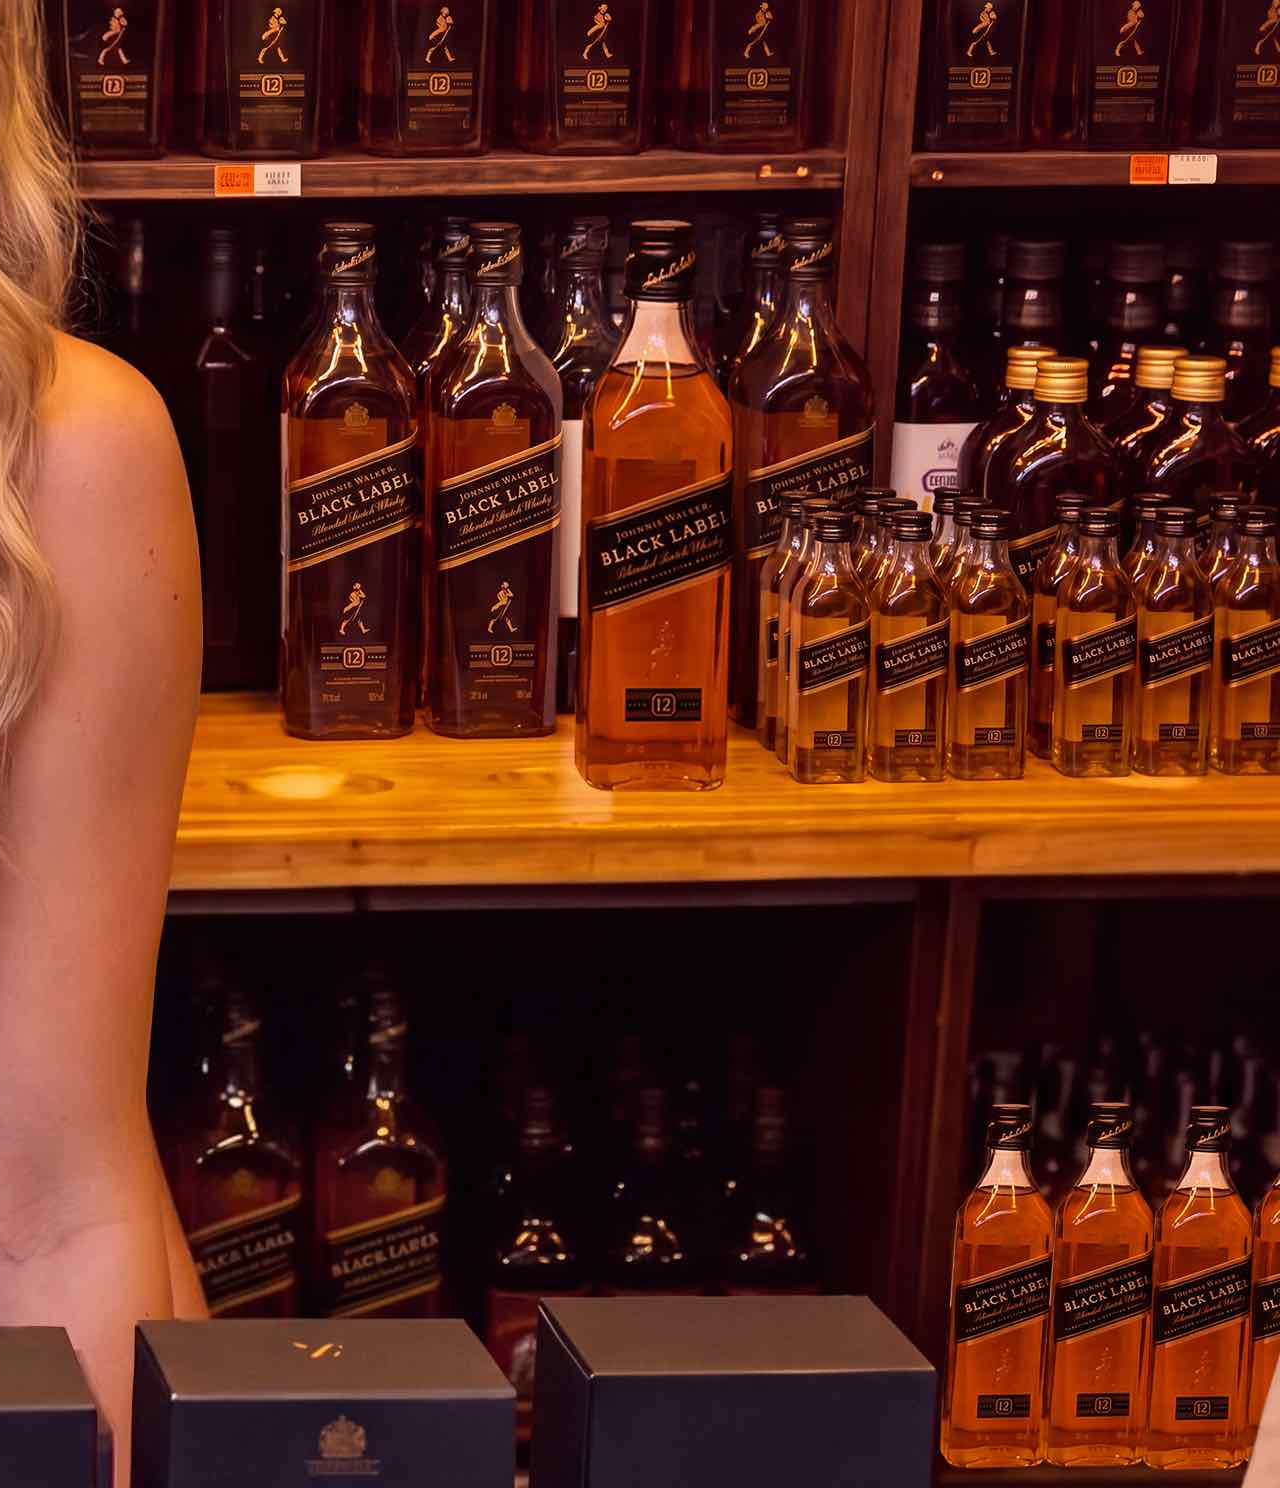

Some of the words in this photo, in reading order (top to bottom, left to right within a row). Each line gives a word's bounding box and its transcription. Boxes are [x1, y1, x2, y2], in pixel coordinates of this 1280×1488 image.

[298, 494, 356, 525] BLACK
[359, 473, 413, 502] LABEL
[445, 494, 503, 524] BLACK
[506, 472, 559, 502] LABEL
[601, 534, 664, 566] BLACK
[669, 511, 729, 542] LABEL
[804, 651, 836, 669] BLACK
[837, 640, 869, 658] LABEL
[884, 651, 916, 669] BLACK
[918, 639, 949, 657] LABEL
[1072, 645, 1104, 663] BLACK
[1106, 635, 1136, 652] LABEL
[965, 1292, 1008, 1313] BLACK
[1064, 1290, 1108, 1312] BLACK
[1163, 1294, 1206, 1315] BLACK
